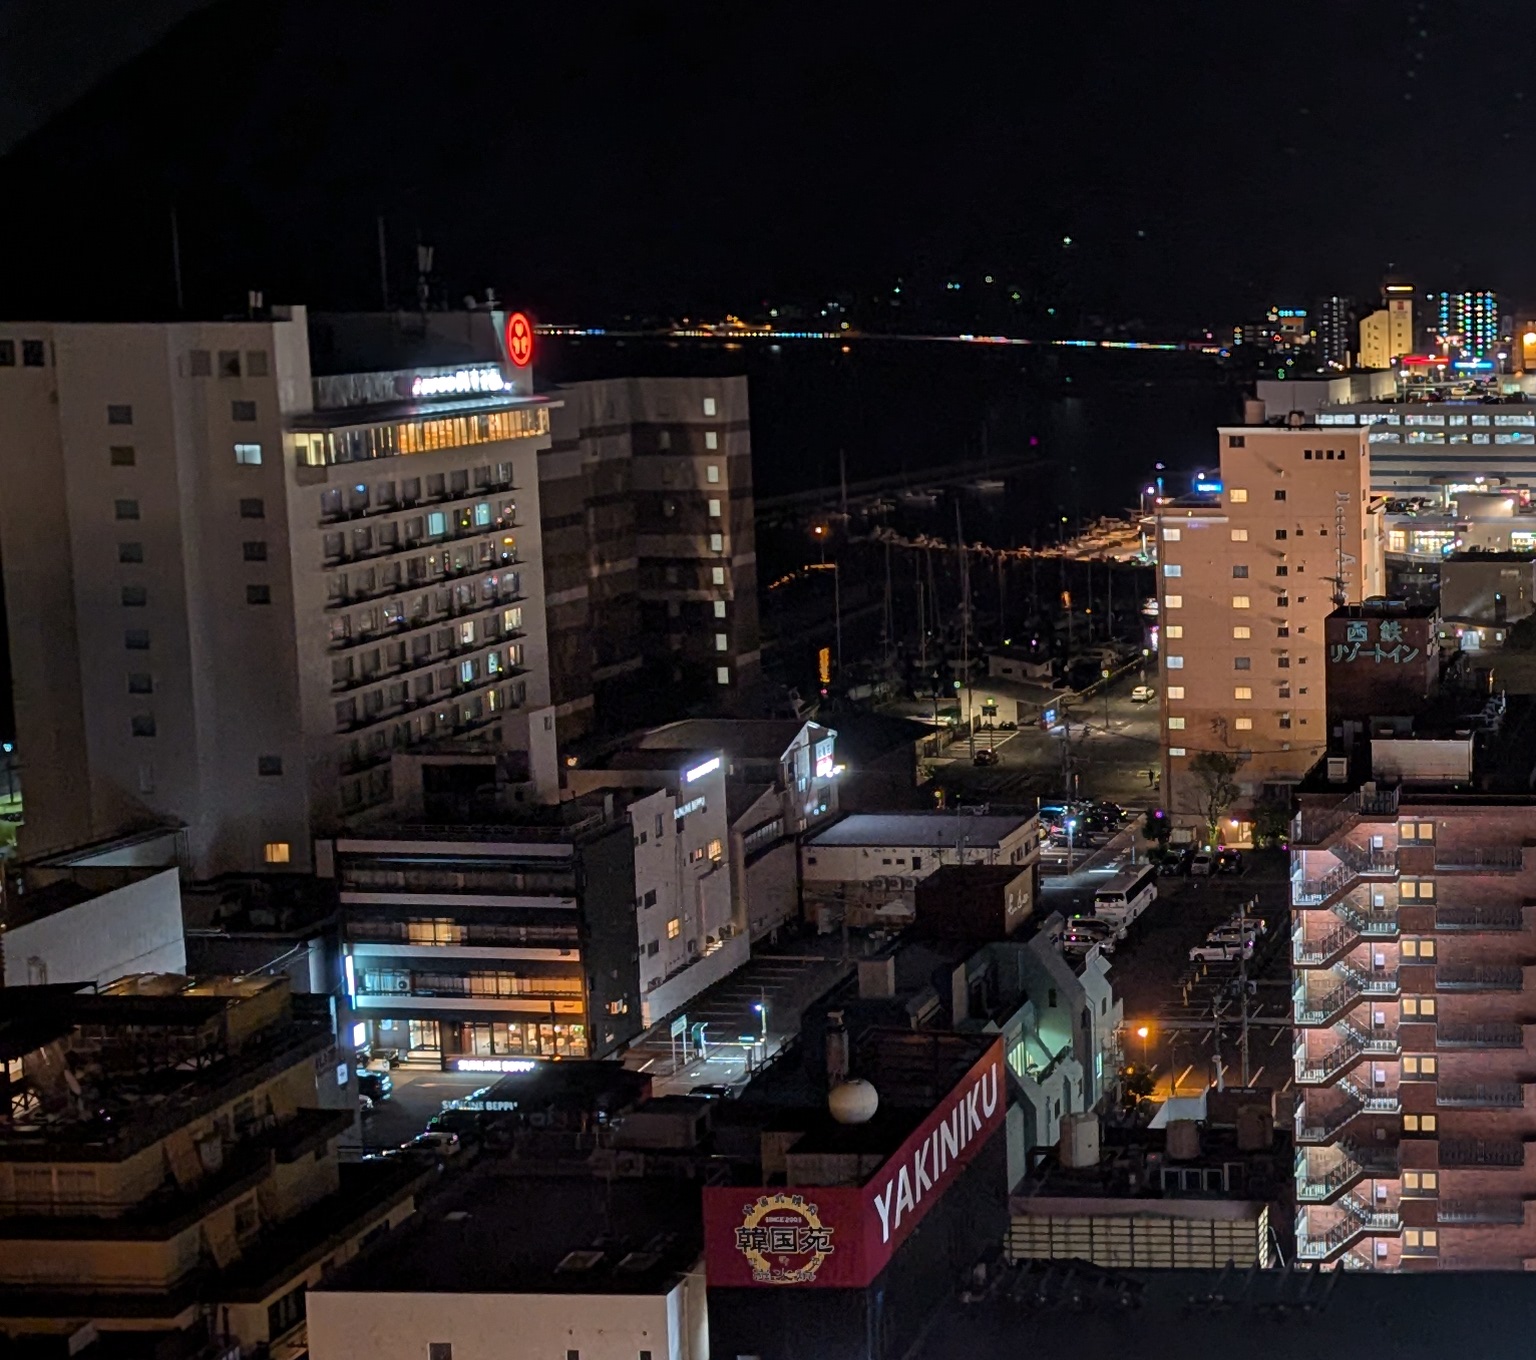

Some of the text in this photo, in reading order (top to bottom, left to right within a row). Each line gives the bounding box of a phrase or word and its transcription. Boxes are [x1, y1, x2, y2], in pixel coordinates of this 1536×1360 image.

[1346, 621, 1403, 643] 西鉄
[1330, 641, 1420, 664] リゾートイン
[873, 1062, 998, 1244] YAKINIKU
[734, 1226, 835, 1254] 韓国苑
